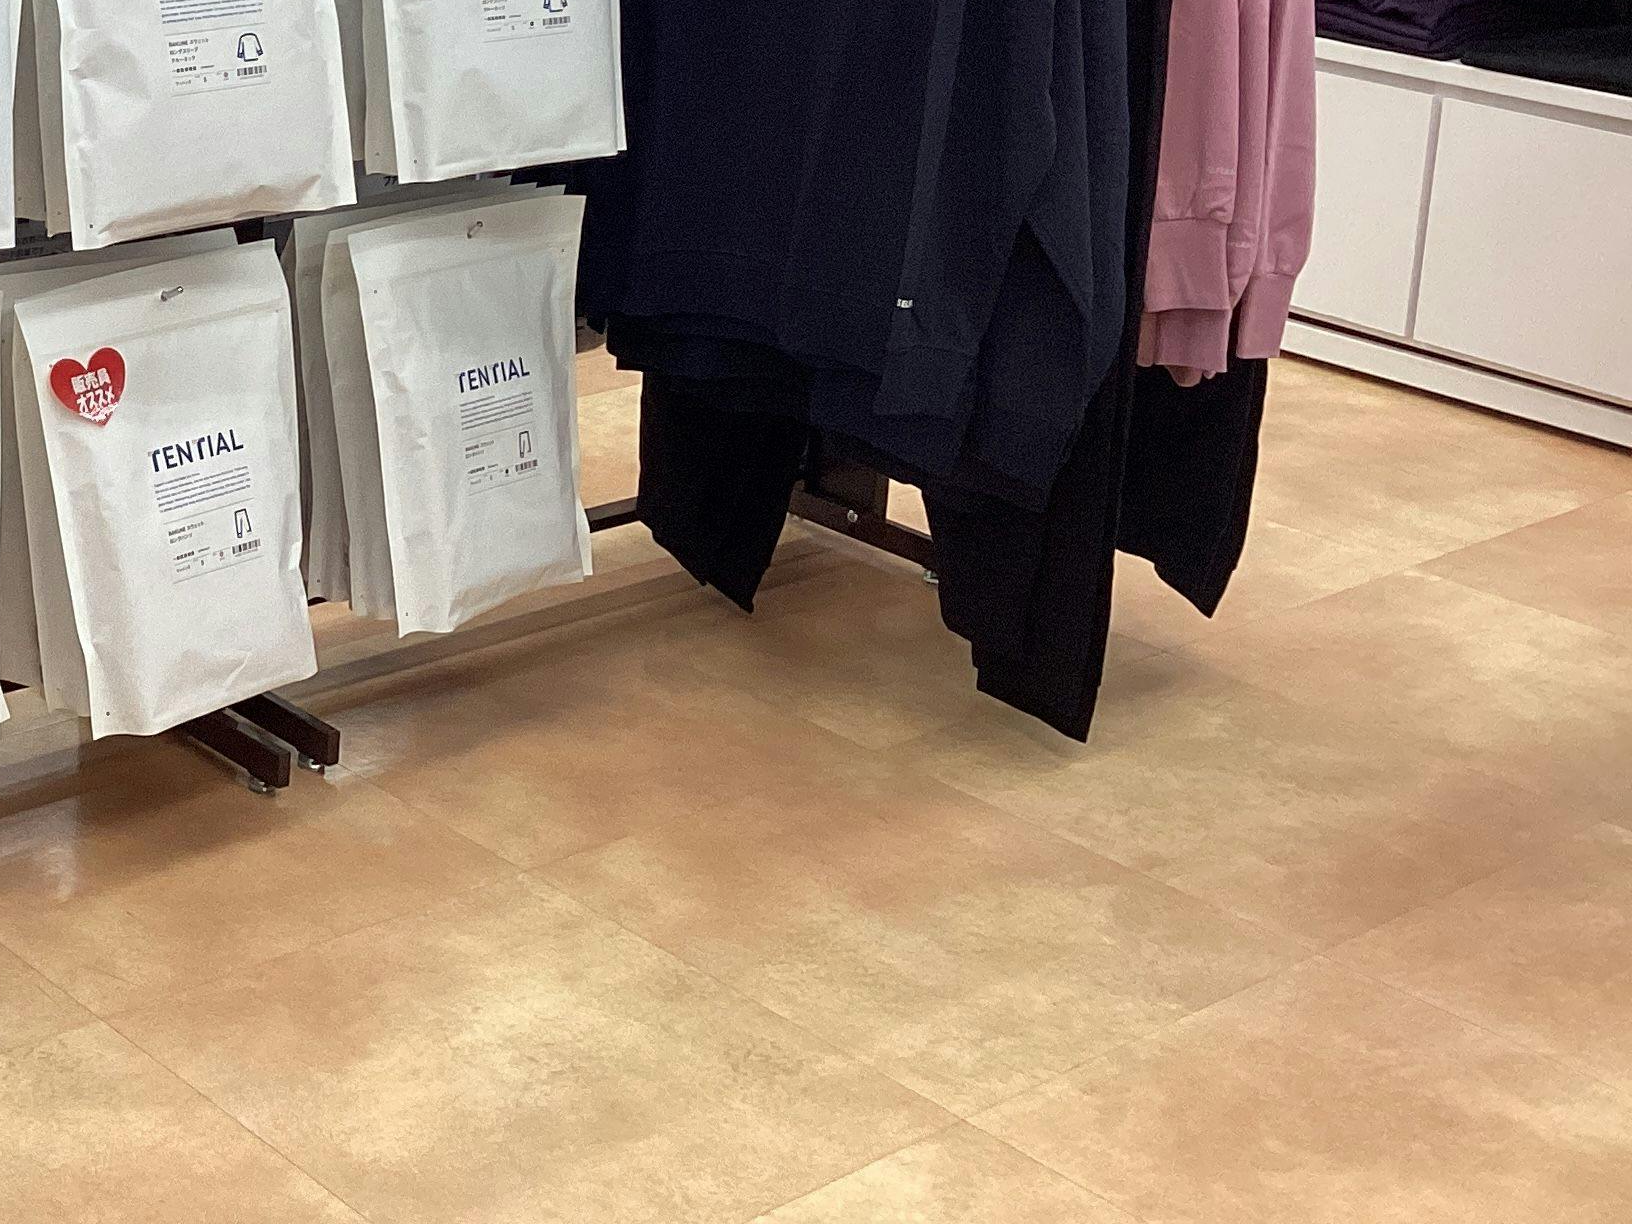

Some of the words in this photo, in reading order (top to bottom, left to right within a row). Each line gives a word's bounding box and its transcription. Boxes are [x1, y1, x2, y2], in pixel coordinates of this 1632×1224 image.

[71, 367, 112, 394] 販売員
[457, 357, 530, 393] TENTIAL
[76, 386, 115, 413] オススメ
[148, 429, 244, 473] TENTIAL
